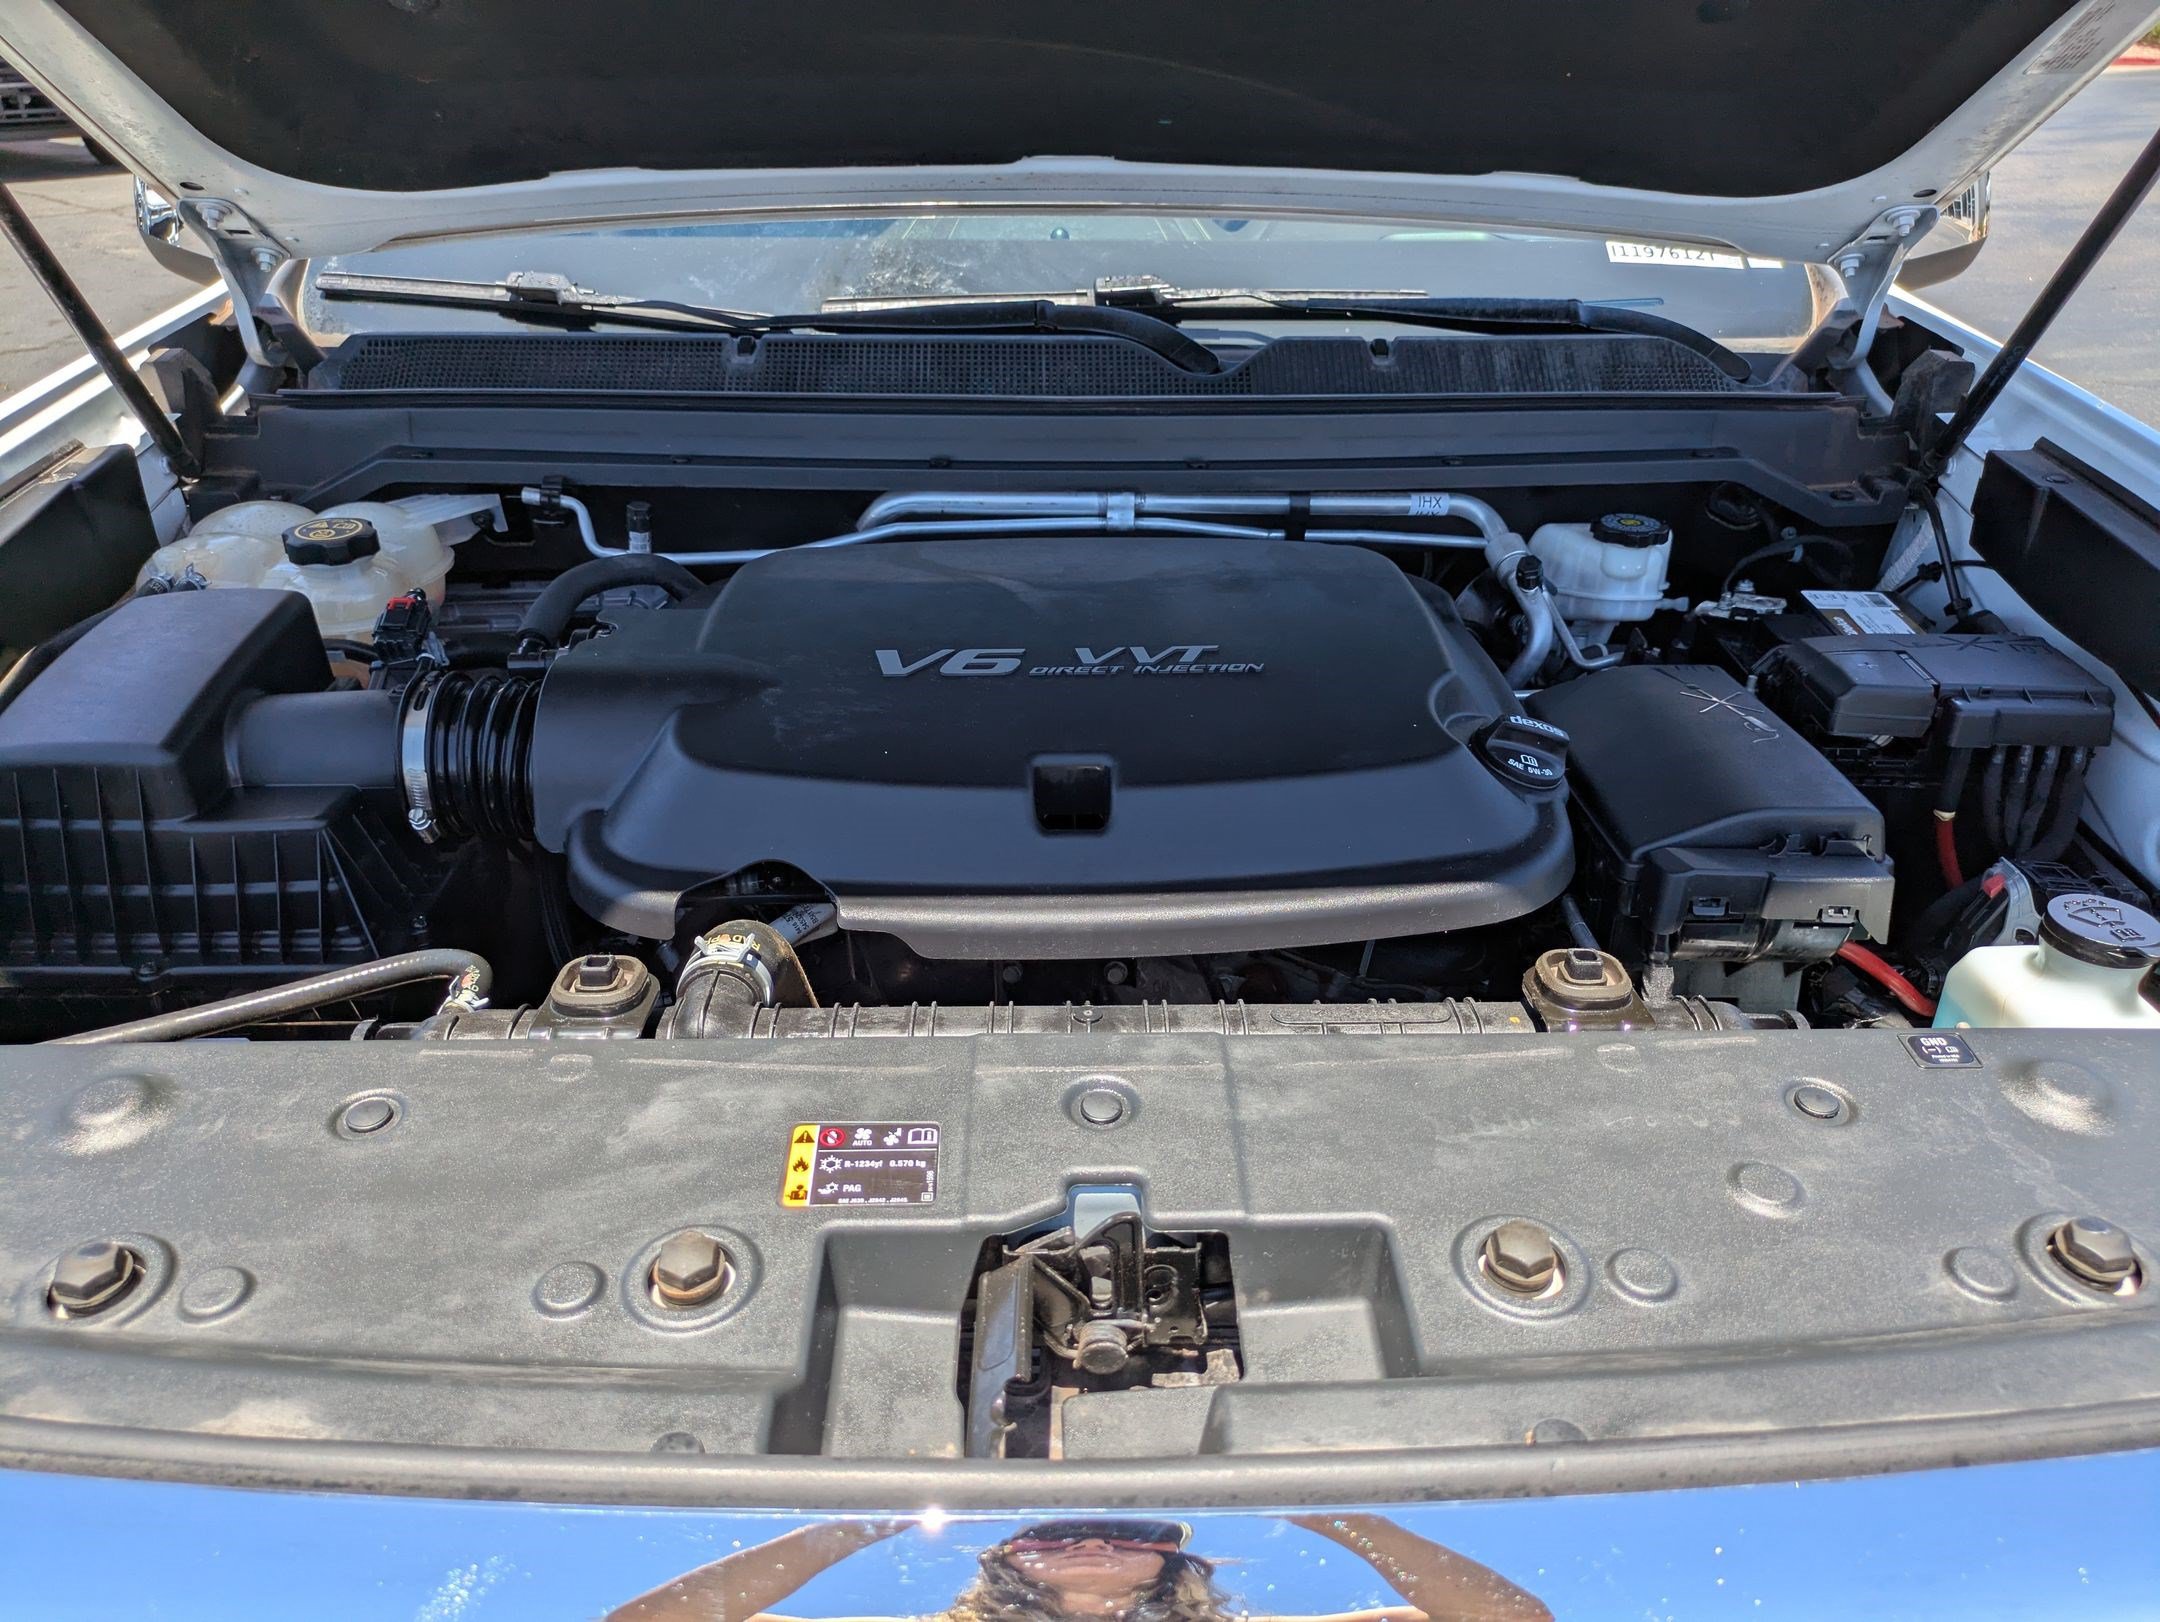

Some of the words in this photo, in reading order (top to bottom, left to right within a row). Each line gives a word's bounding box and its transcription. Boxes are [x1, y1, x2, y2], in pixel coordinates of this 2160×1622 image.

[875, 648, 1026, 677] V6
[1074, 644, 1220, 665] VVT
[1028, 664, 1125, 677] DIRECT
[1133, 662, 1265, 676] INJECTION
[1510, 715, 1565, 737] dexos
[1507, 758, 1525, 771] SAE
[1920, 1037, 1948, 1046] GND
[844, 1159, 884, 1168] R-1234yf
[889, 1159, 914, 1168] 0.570
[915, 1159, 927, 1168] kg
[842, 1184, 862, 1193] PAG
